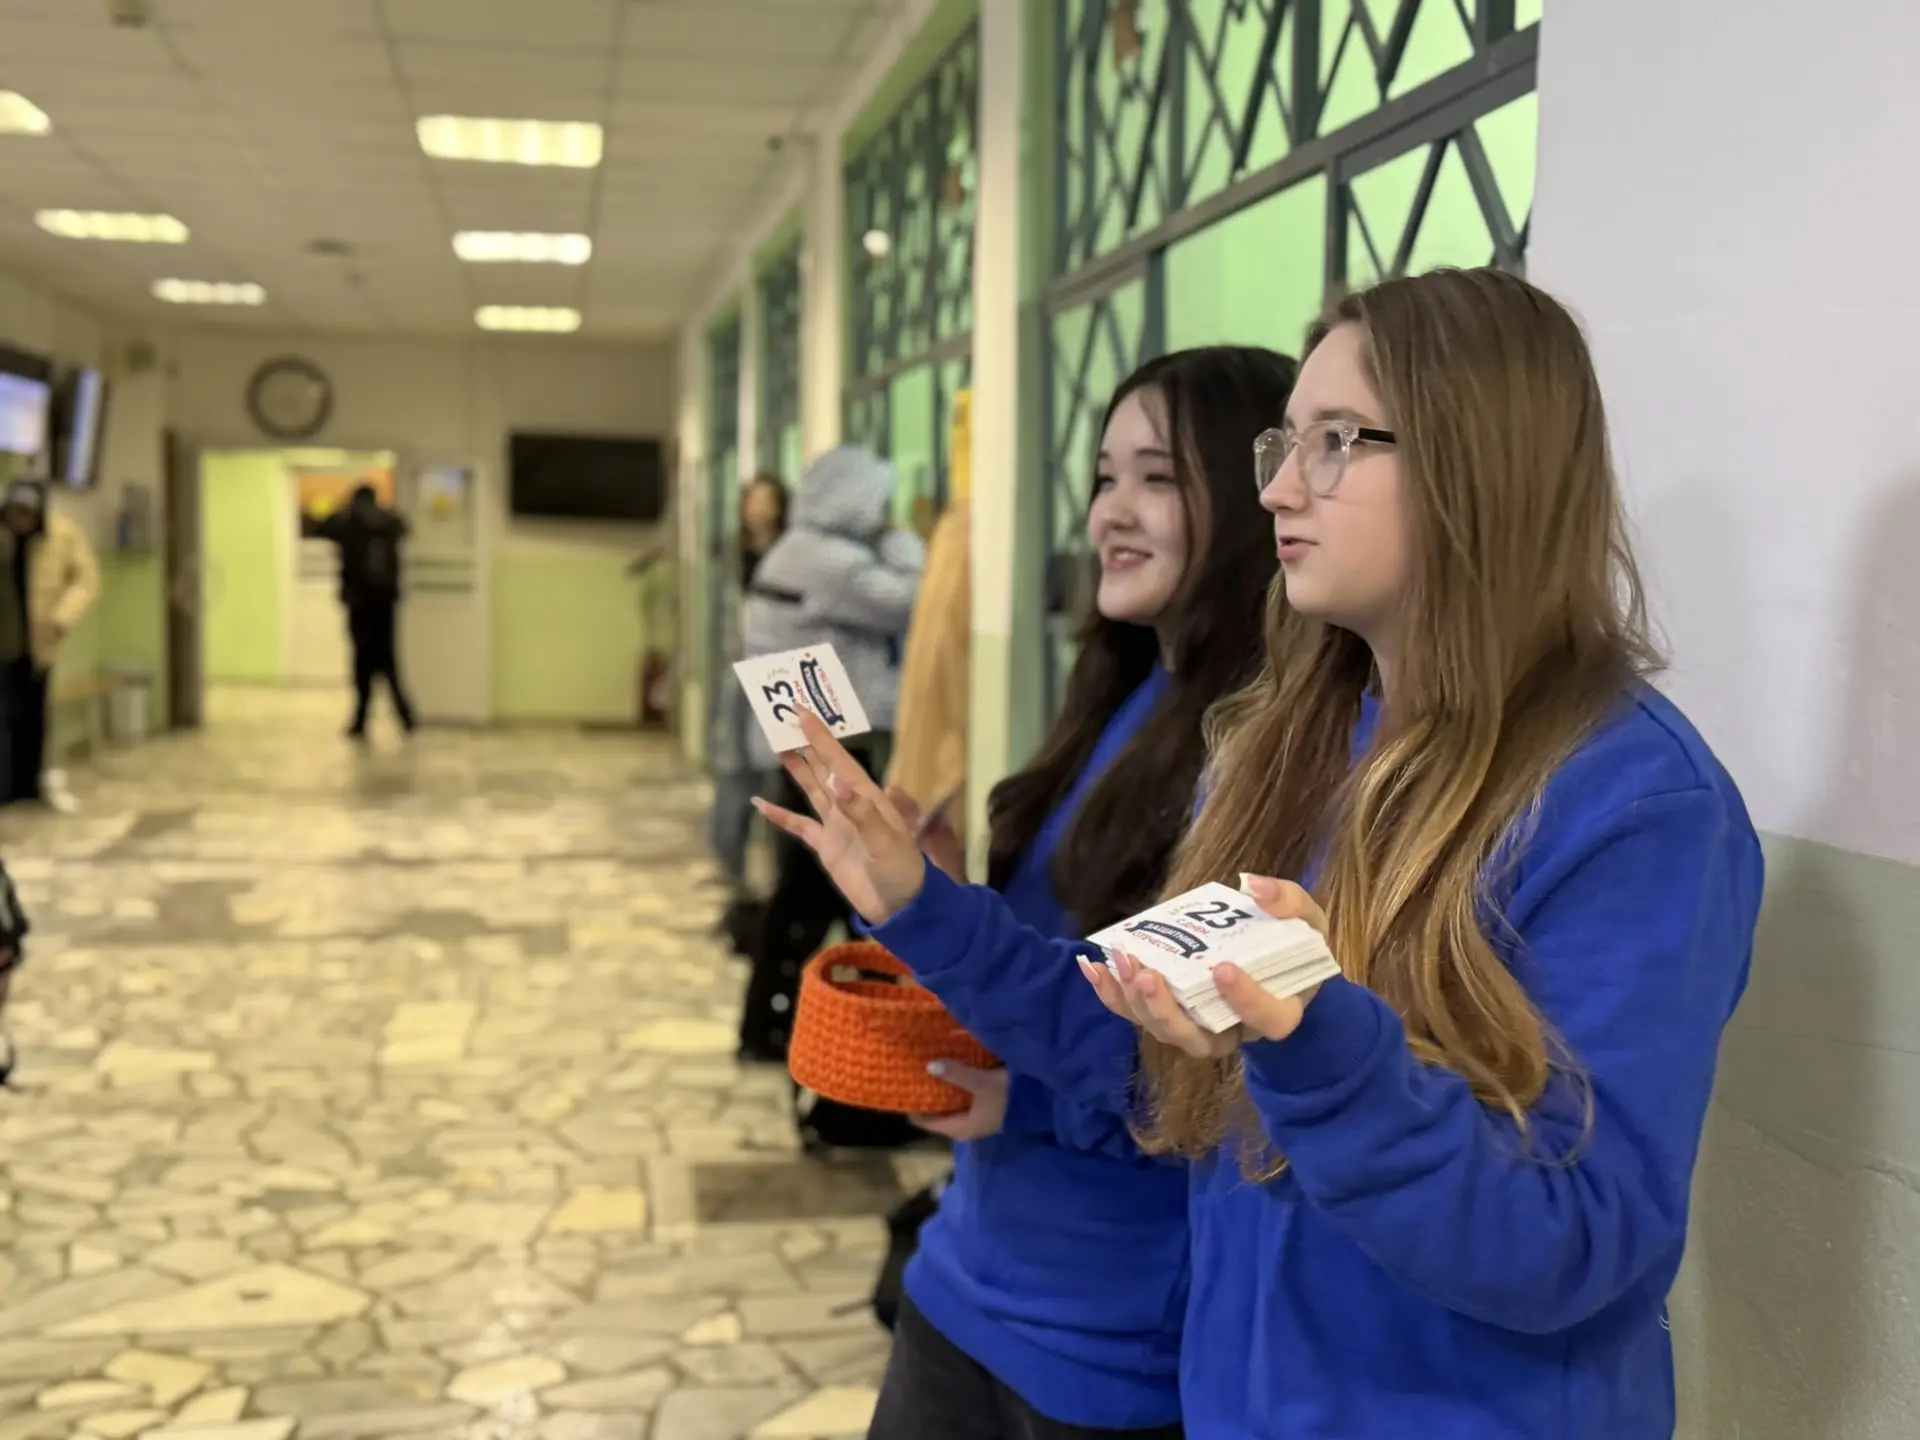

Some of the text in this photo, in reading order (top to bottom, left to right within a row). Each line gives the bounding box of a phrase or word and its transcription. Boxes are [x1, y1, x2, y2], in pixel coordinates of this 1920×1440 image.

[762, 680, 799, 722] 23
[1184, 901, 1254, 929] 23
[1132, 931, 1179, 954] ОТЕЧЕСТВА
[1143, 923, 1200, 950] ЗАЩИТНИКА
